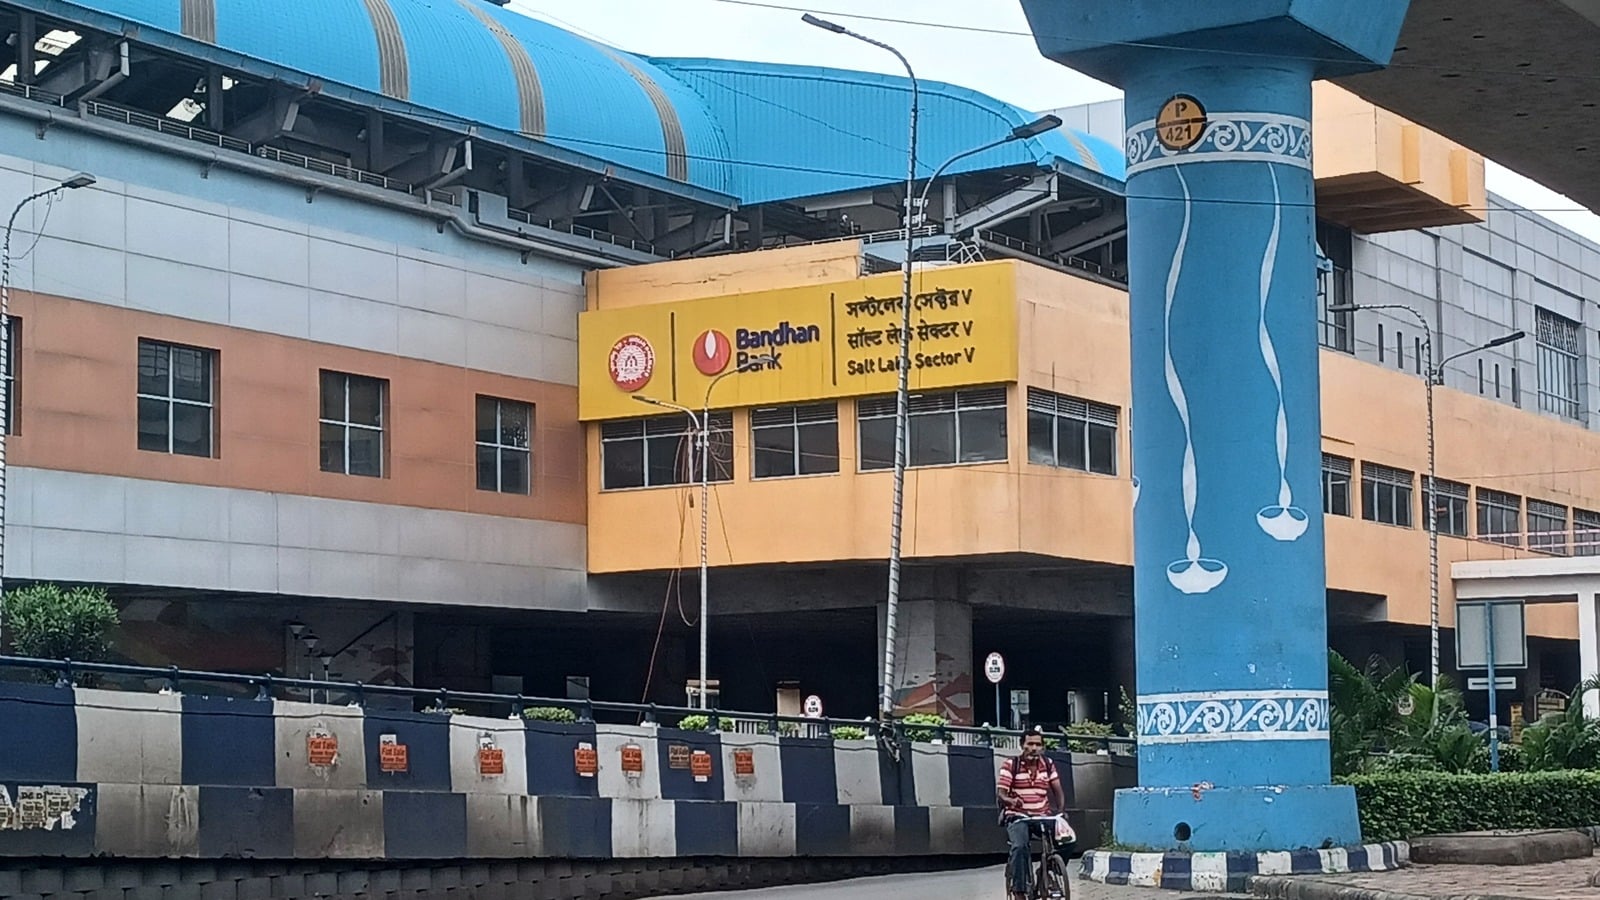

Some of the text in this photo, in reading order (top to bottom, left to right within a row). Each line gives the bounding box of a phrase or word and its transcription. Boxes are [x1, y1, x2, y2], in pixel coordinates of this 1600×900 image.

[1175, 102, 1187, 118] P
[1165, 124, 1192, 142] 421
[961, 288, 972, 305] V
[736, 321, 820, 350] Bandhan
[846, 326, 882, 349] सॉल्ट
[916, 319, 960, 341] सेक्टर
[962, 320, 973, 336] V
[736, 346, 782, 373] Bank
[847, 359, 875, 375] Salt
[915, 352, 961, 369] Sector
[963, 347, 975, 363] V
